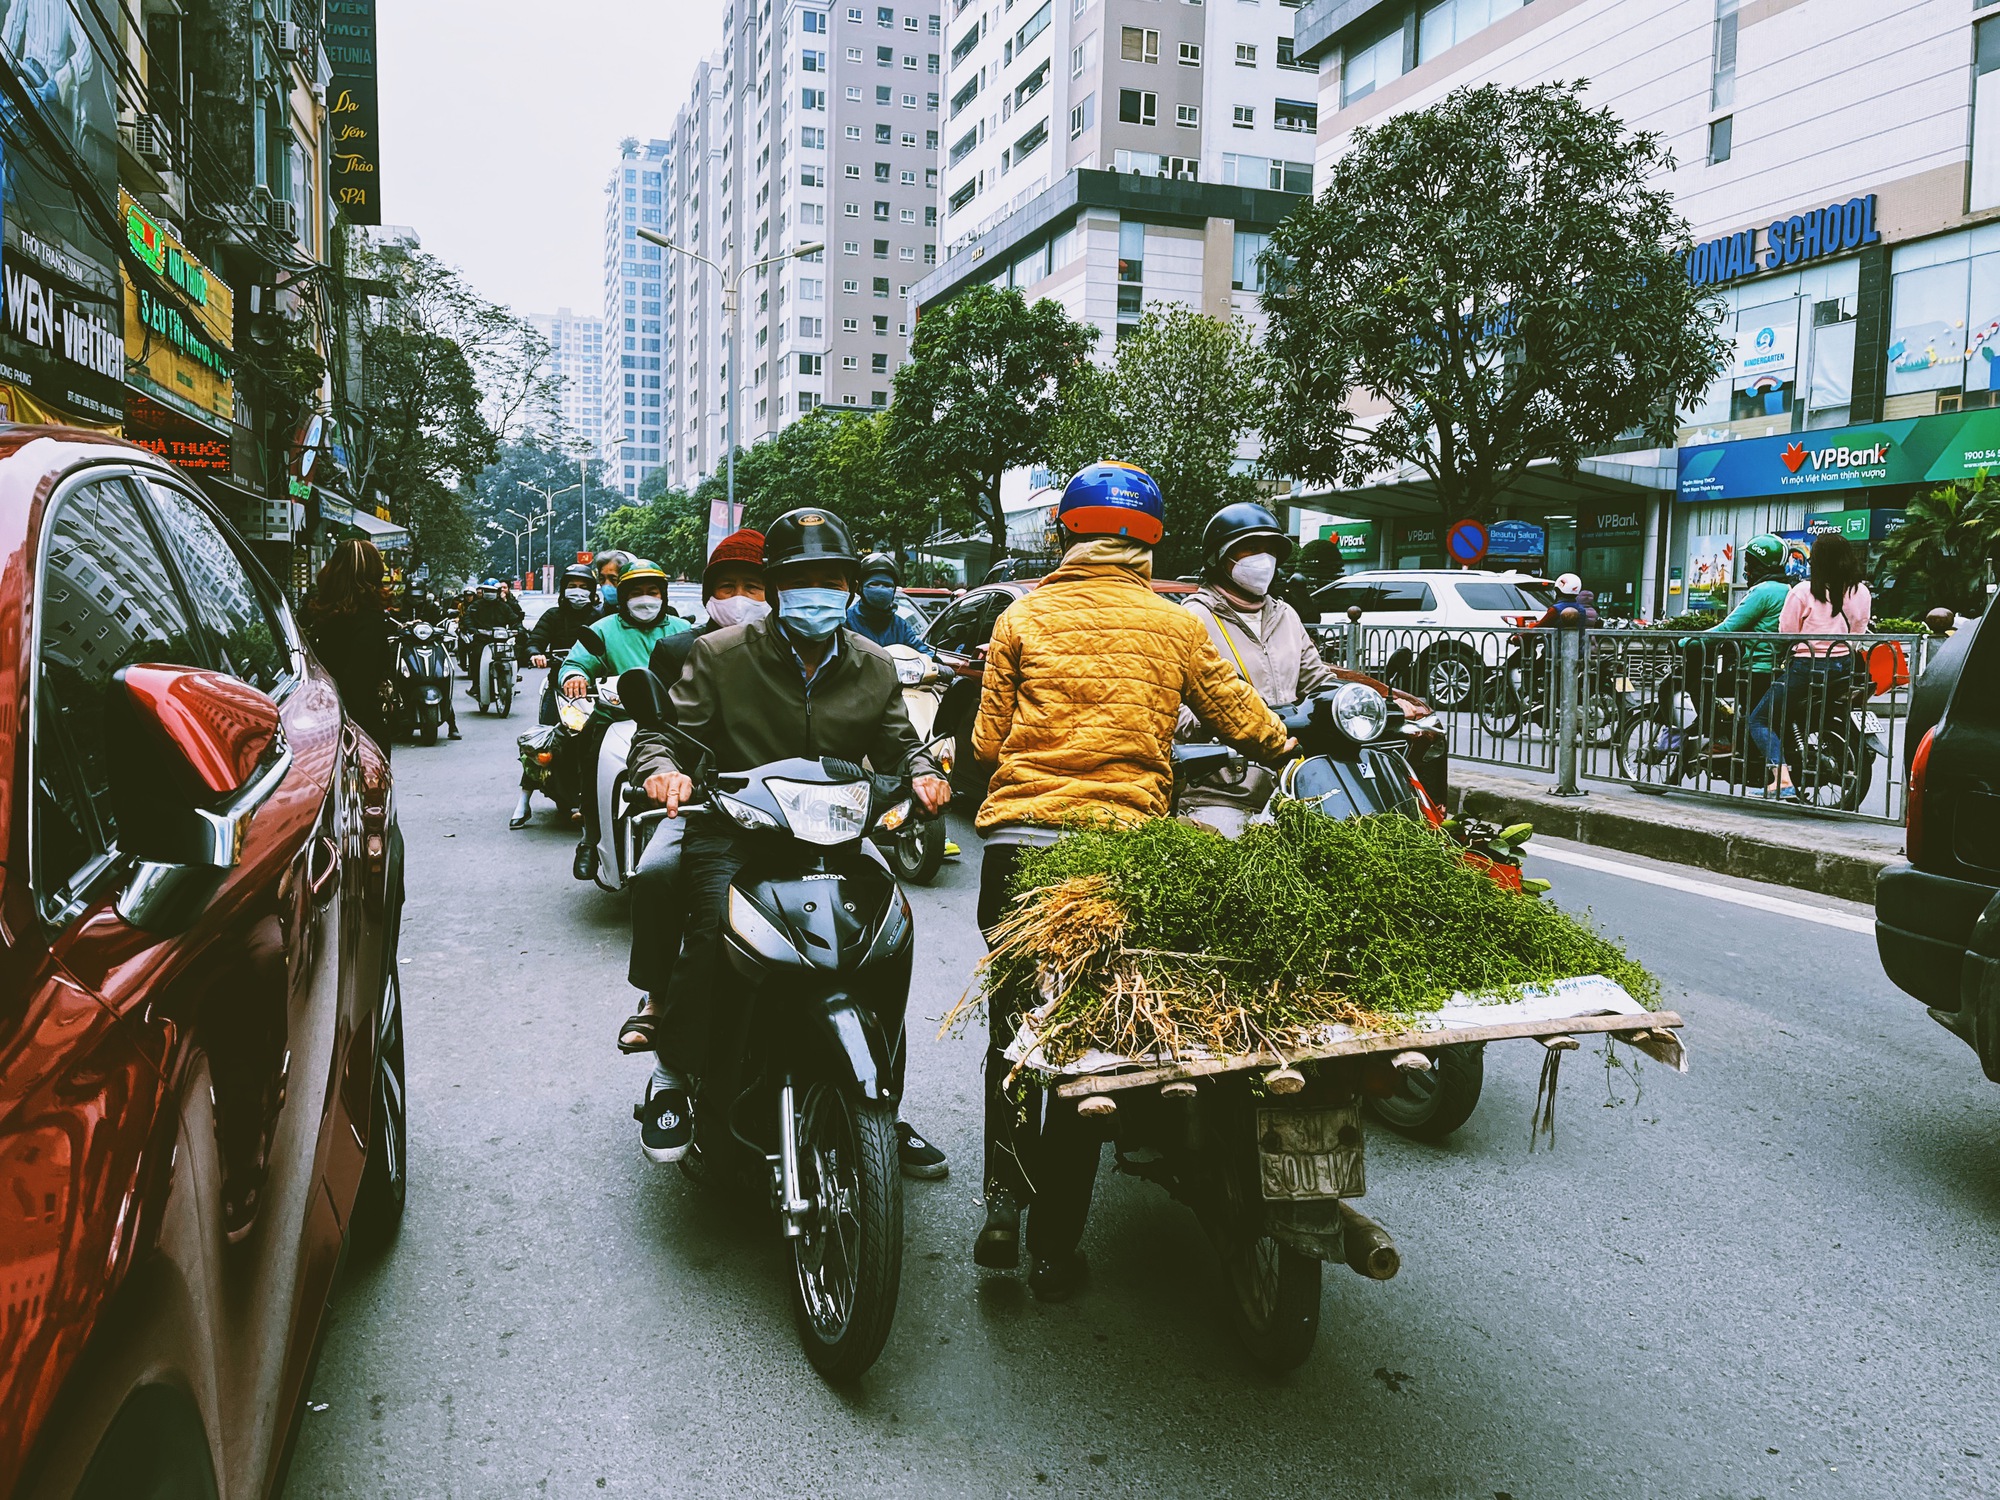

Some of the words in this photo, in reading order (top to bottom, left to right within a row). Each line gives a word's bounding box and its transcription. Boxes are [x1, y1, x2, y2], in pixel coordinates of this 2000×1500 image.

[339, 187, 366, 205] SPA
[1765, 193, 1881, 270] SCHOOL
[1743, 352, 1785, 368] KINDERGARTEN
[1810, 442, 1888, 470] VPBank
[1964, 450, 1984, 460] 1900
[1985, 449, 1996, 459] 54
[1789, 475, 1804, 486] một
[1805, 474, 1820, 484] Việt
[1821, 473, 1839, 481] Nam
[1840, 470, 1860, 481] thịnh
[1861, 469, 1886, 480] vượng
[1119, 489, 1140, 499] VNVC
[1597, 512, 1639, 528] VPBank
[1407, 529, 1436, 542] VPBank
[1490, 530, 1517, 542] Beauty
[1806, 525, 1843, 536] eXpress
[1340, 534, 1366, 546] VPBank
[1751, 543, 1767, 557] Grab
[802, 873, 847, 881] HONDA
